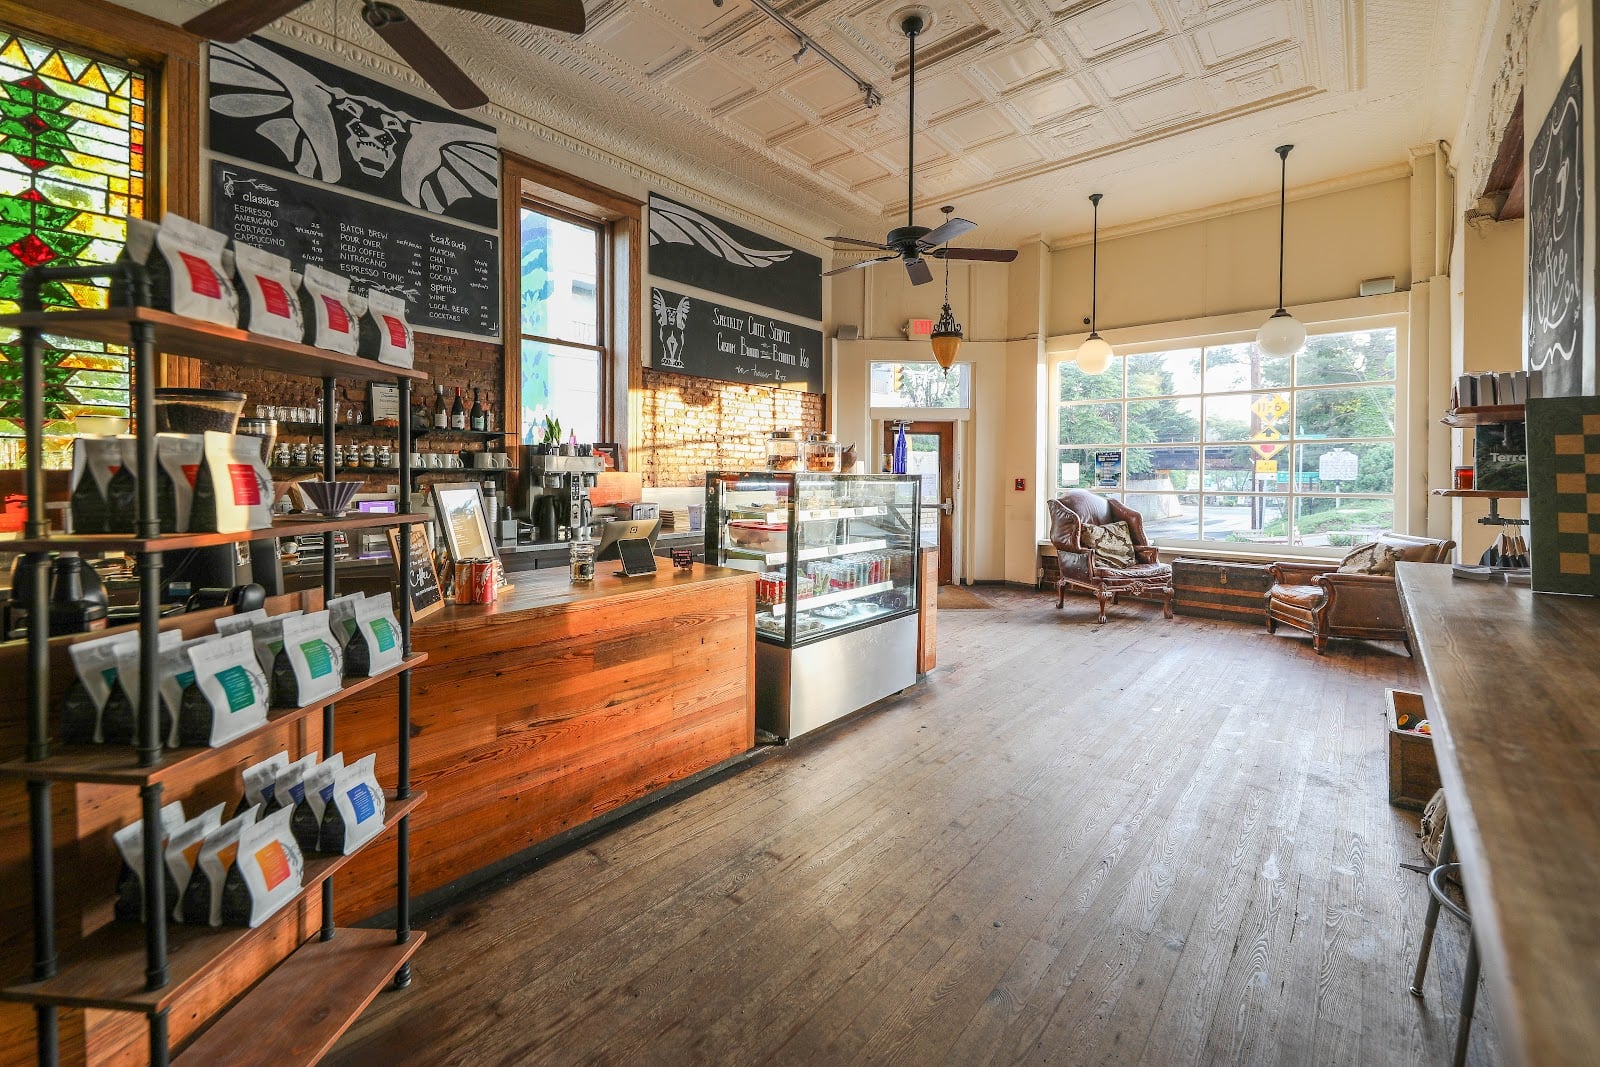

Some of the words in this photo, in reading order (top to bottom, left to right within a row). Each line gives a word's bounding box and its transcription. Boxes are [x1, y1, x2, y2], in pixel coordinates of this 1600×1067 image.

[242, 191, 280, 208] classics
[234, 204, 272, 219] ESPRESSO
[234, 214, 279, 228] AMERICANO
[234, 223, 273, 236] CORTADO
[340, 222, 365, 235] BATCH
[368, 229, 388, 239] BREW
[234, 232, 285, 247] CAPPUCCINO
[340, 233, 360, 244] POUR
[362, 238, 382, 249] OVER
[340, 243, 357, 253] ICED
[358, 247, 385, 260] COFFEE
[430, 246, 456, 259] MATCHA
[340, 252, 387, 269] NITROCANO
[430, 255, 446, 264] CHAI
[340, 263, 379, 277] ESPRESSO
[382, 271, 405, 284] TONIC
[430, 263, 443, 272] HOT
[445, 266, 459, 275] TEA
[430, 272, 453, 283] COCOA
[429, 303, 450, 311] LOCAL
[451, 305, 470, 315] BEER
[429, 311, 461, 322] COCKTAILS
